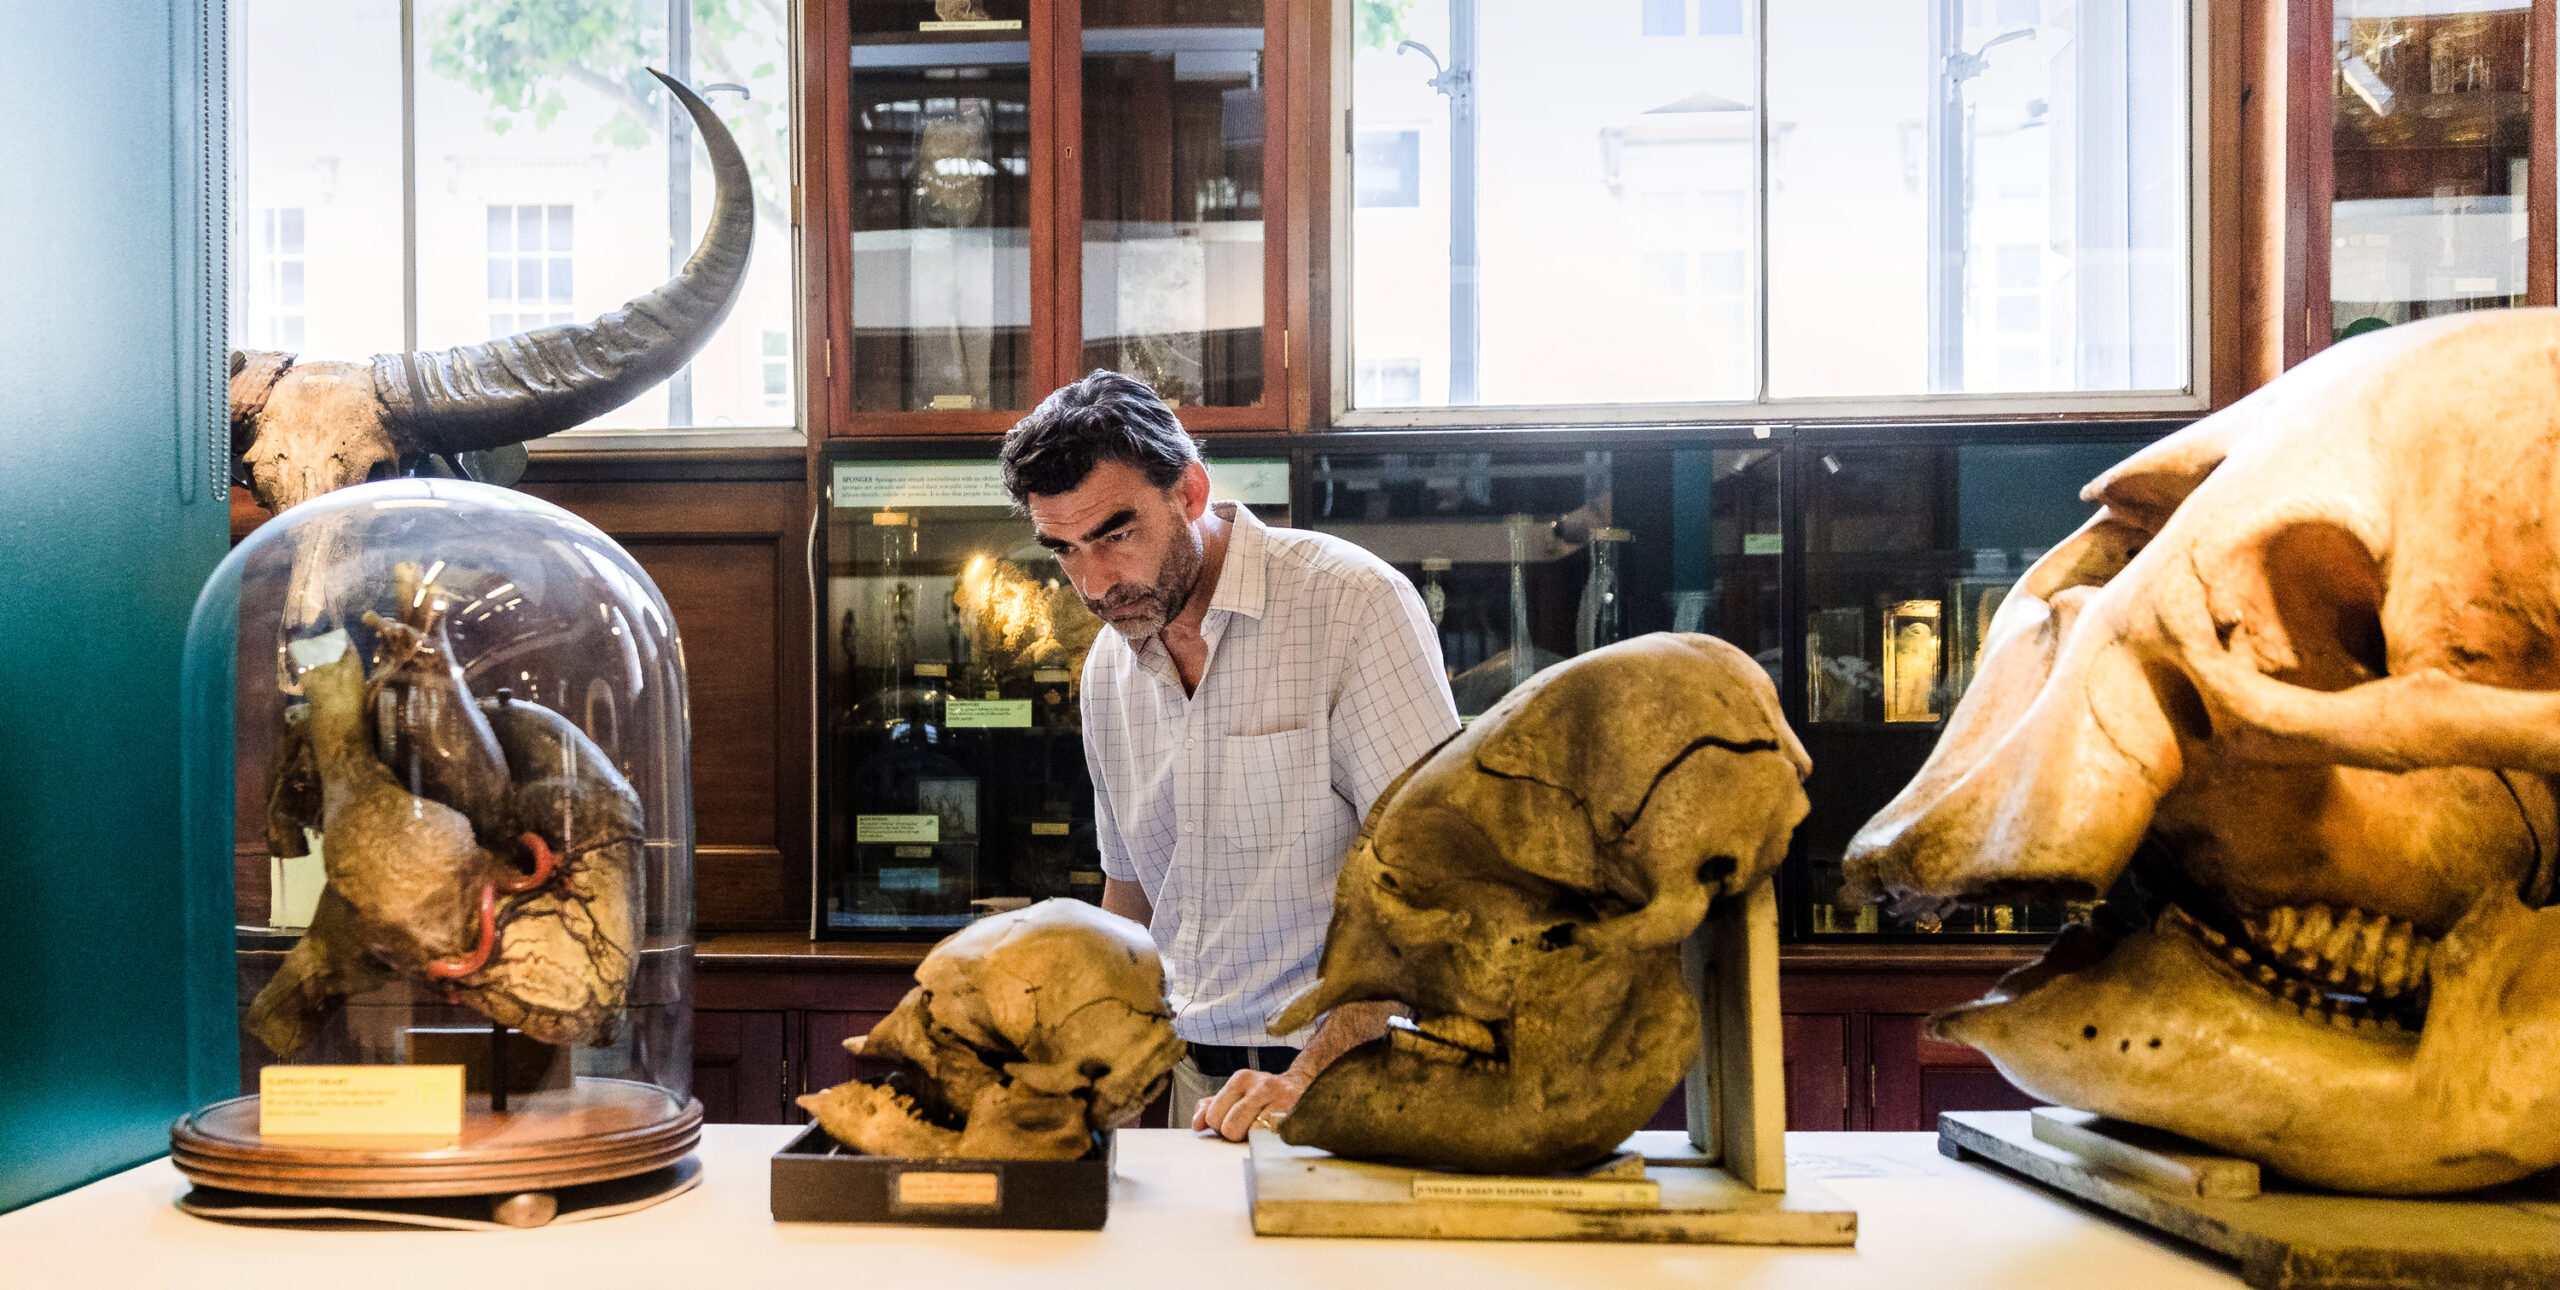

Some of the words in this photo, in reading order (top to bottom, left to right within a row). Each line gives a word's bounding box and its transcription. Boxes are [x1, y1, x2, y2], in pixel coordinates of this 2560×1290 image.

[265, 1077, 315, 1087] ELEPHANT
[318, 1077, 350, 1087] HEART
[1416, 1187, 1462, 1195] JUVENILE
[1465, 1187, 1494, 1195] ASIAN
[1496, 1187, 1548, 1196] ELEPHANT
